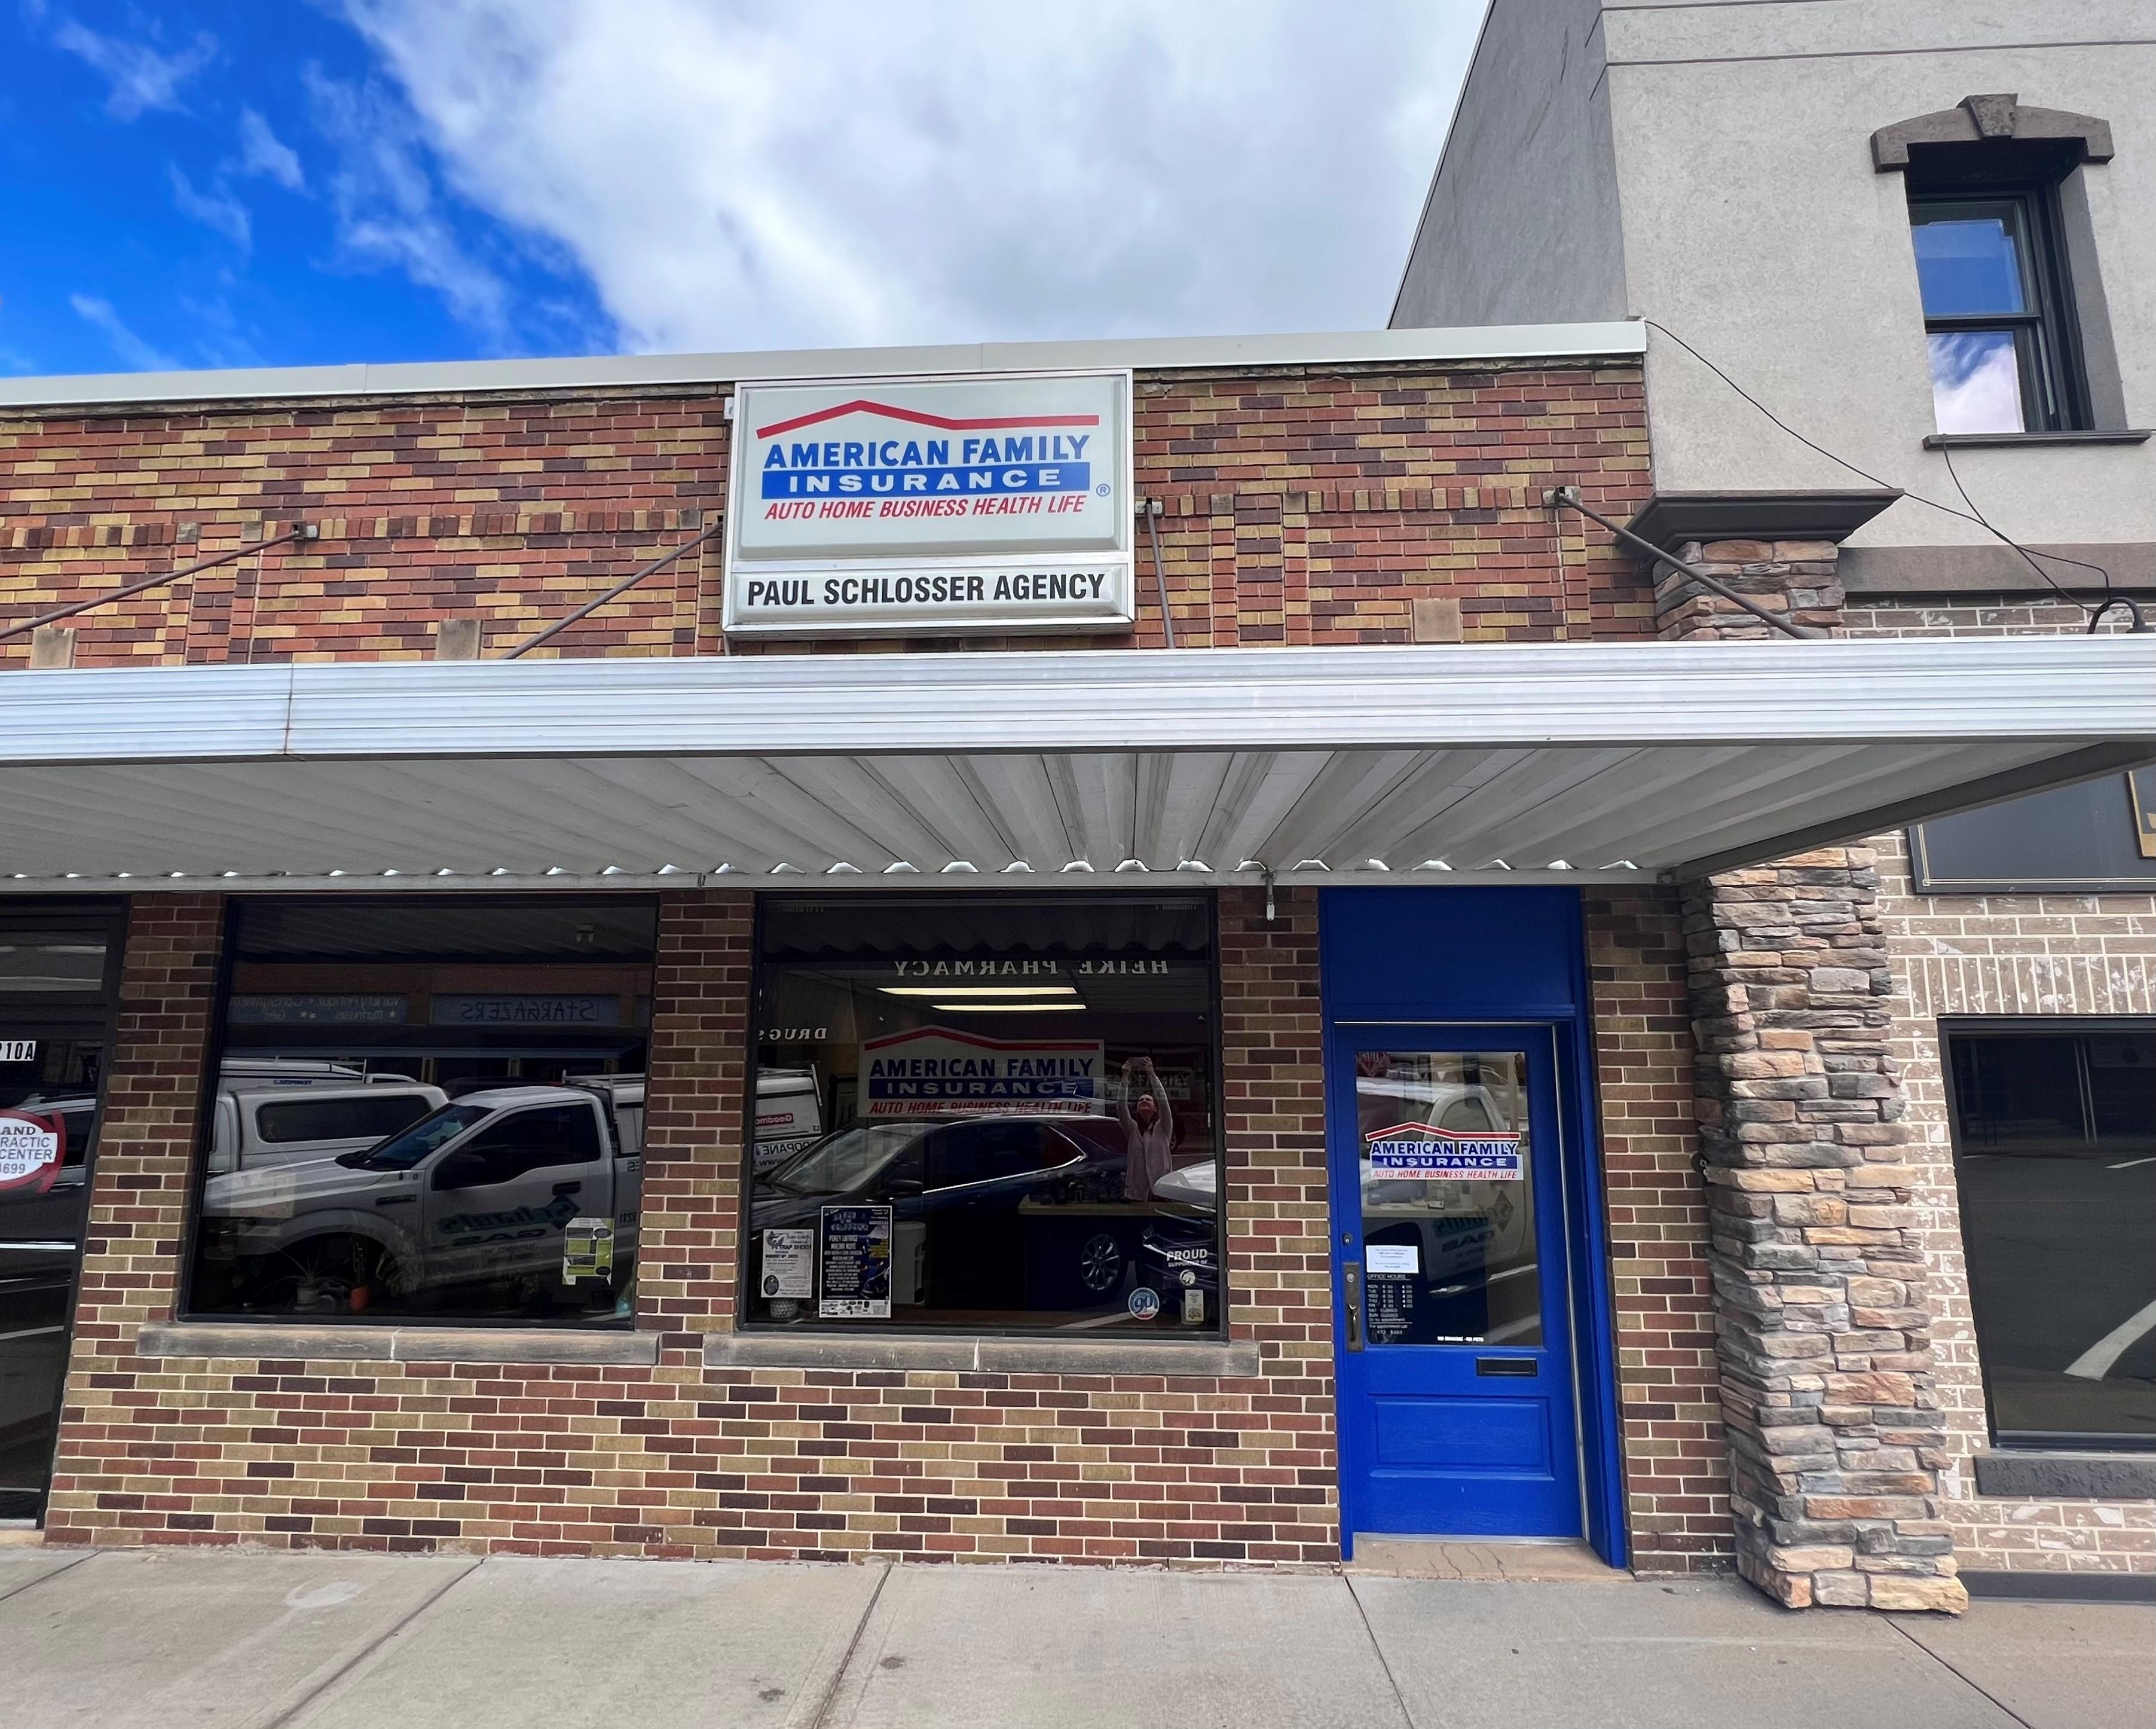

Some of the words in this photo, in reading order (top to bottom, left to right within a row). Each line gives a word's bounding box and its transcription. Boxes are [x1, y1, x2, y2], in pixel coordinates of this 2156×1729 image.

[763, 439, 949, 469] AMERICAN
[963, 435, 1091, 465] FAMILY
[790, 469, 1060, 493] INSURANCE
[764, 500, 814, 520] AUTO
[819, 500, 873, 518] HOME
[880, 499, 968, 518] BUSINESS
[973, 496, 1042, 515] HEALTH
[1047, 495, 1087, 513] LIFE
[748, 580, 814, 606] PAUL
[824, 576, 984, 604] SCHLOSSER
[993, 573, 1105, 601] AGENCY
[0, 1043, 33, 1060] 10A
[870, 1059, 995, 1077] AMERICAN
[1007, 1058, 1094, 1077] FAMILY
[887, 1080, 1077, 1095] INSURANCE
[869, 1102, 903, 1114] AUTO
[908, 1102, 945, 1114] HOME
[0, 1137, 50, 1148] RACTIC
[1372, 1143, 1454, 1155] AMERICAN
[1459, 1143, 1516, 1155] FAMILY
[0, 1148, 53, 1160] CENTER
[0, 1163, 26, 1174] 699
[1383, 1157, 1507, 1167] INSURANCE
[1500, 1170, 1516, 1178] LIFE
[1167, 1248, 1208, 1261] PROUD
